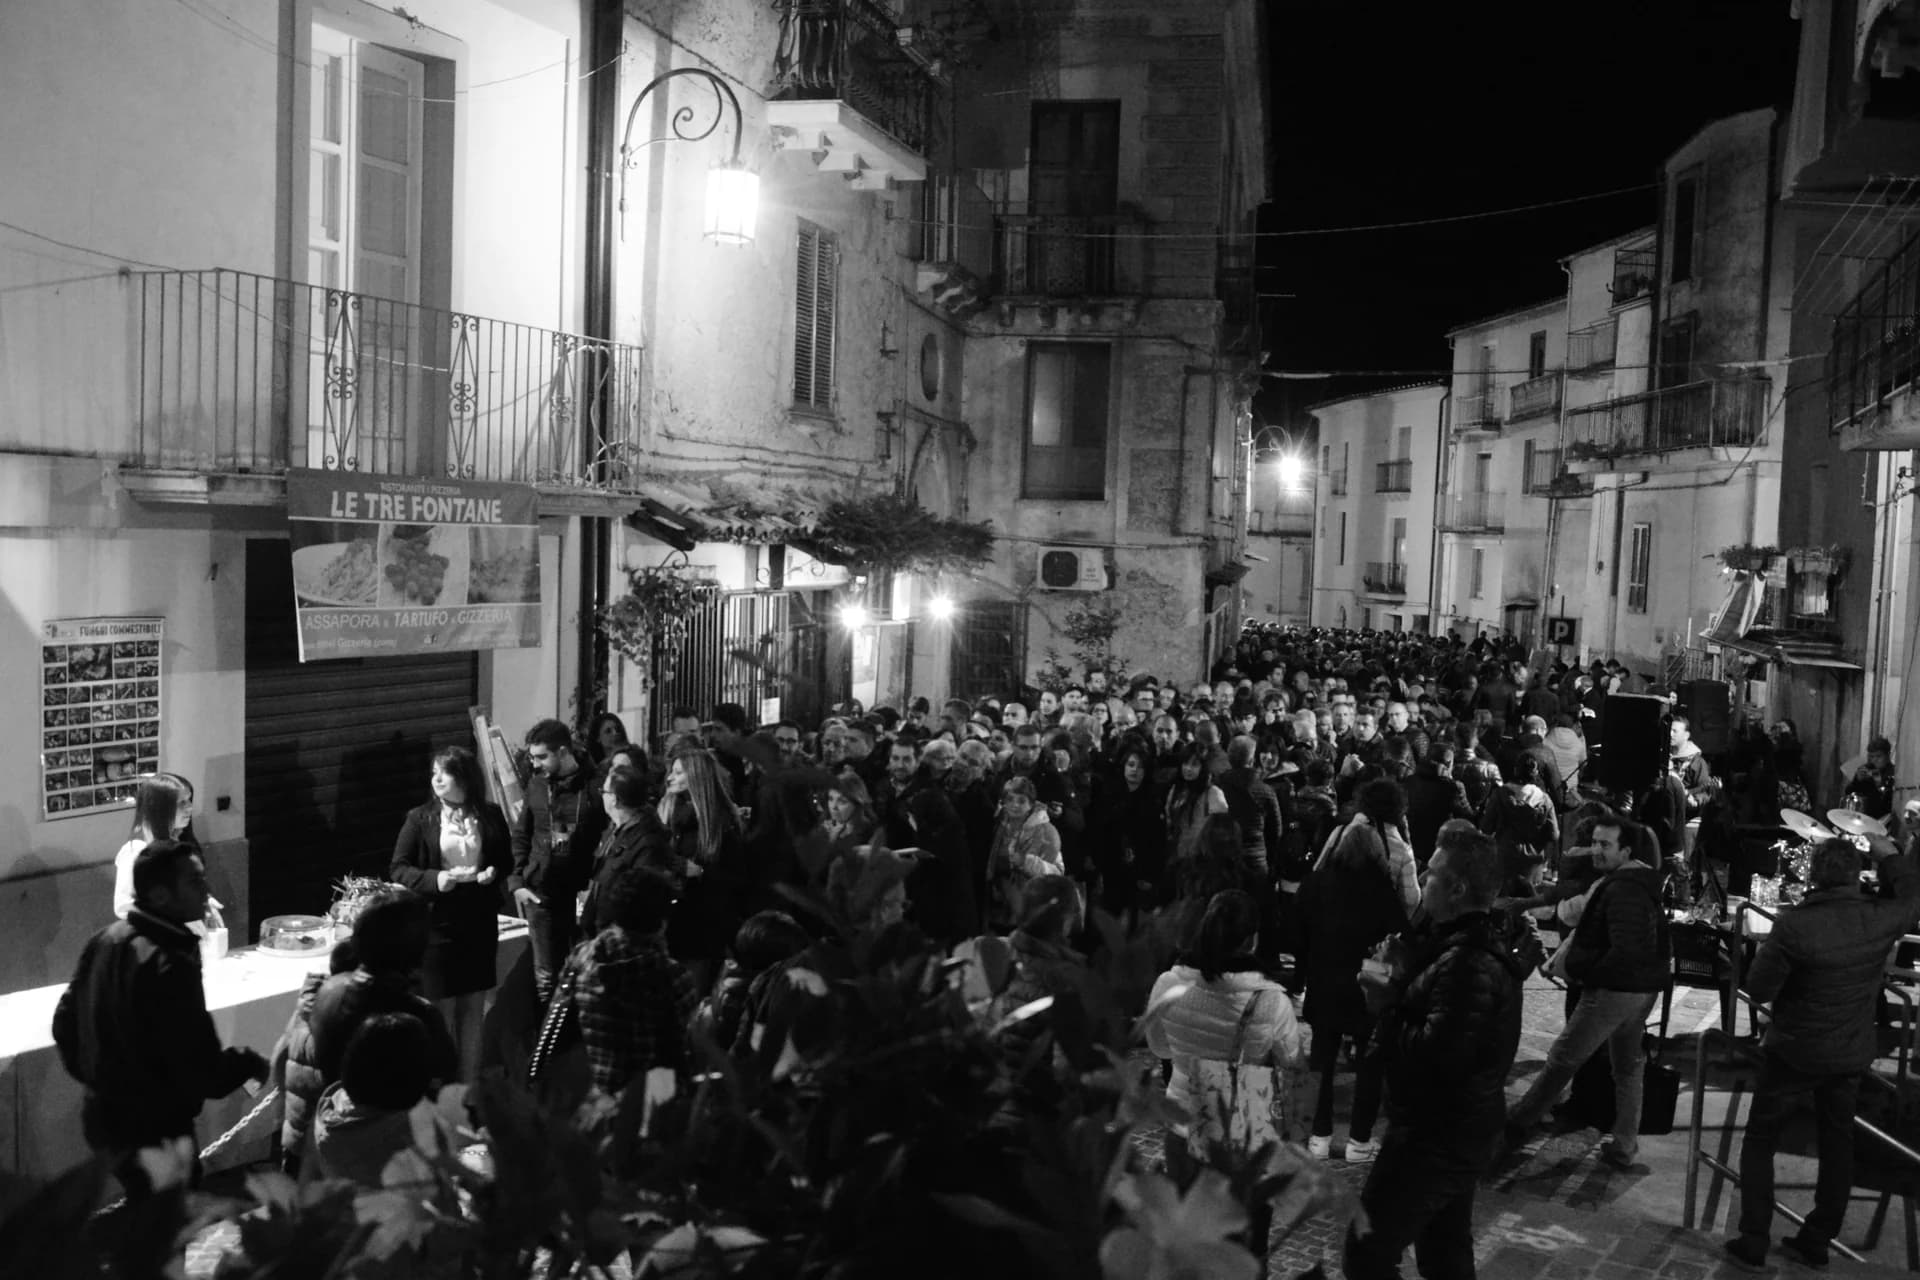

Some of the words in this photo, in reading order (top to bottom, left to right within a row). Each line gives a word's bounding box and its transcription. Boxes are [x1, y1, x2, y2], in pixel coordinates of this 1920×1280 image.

[331, 491, 358, 518] LE
[364, 494, 406, 520] TRE
[411, 497, 502, 522] FONTANE
[305, 614, 380, 629] ASSAPORA
[394, 611, 448, 627] TARTUFO
[457, 609, 512, 624] GIZZERIA
[1554, 621, 1569, 641] P
